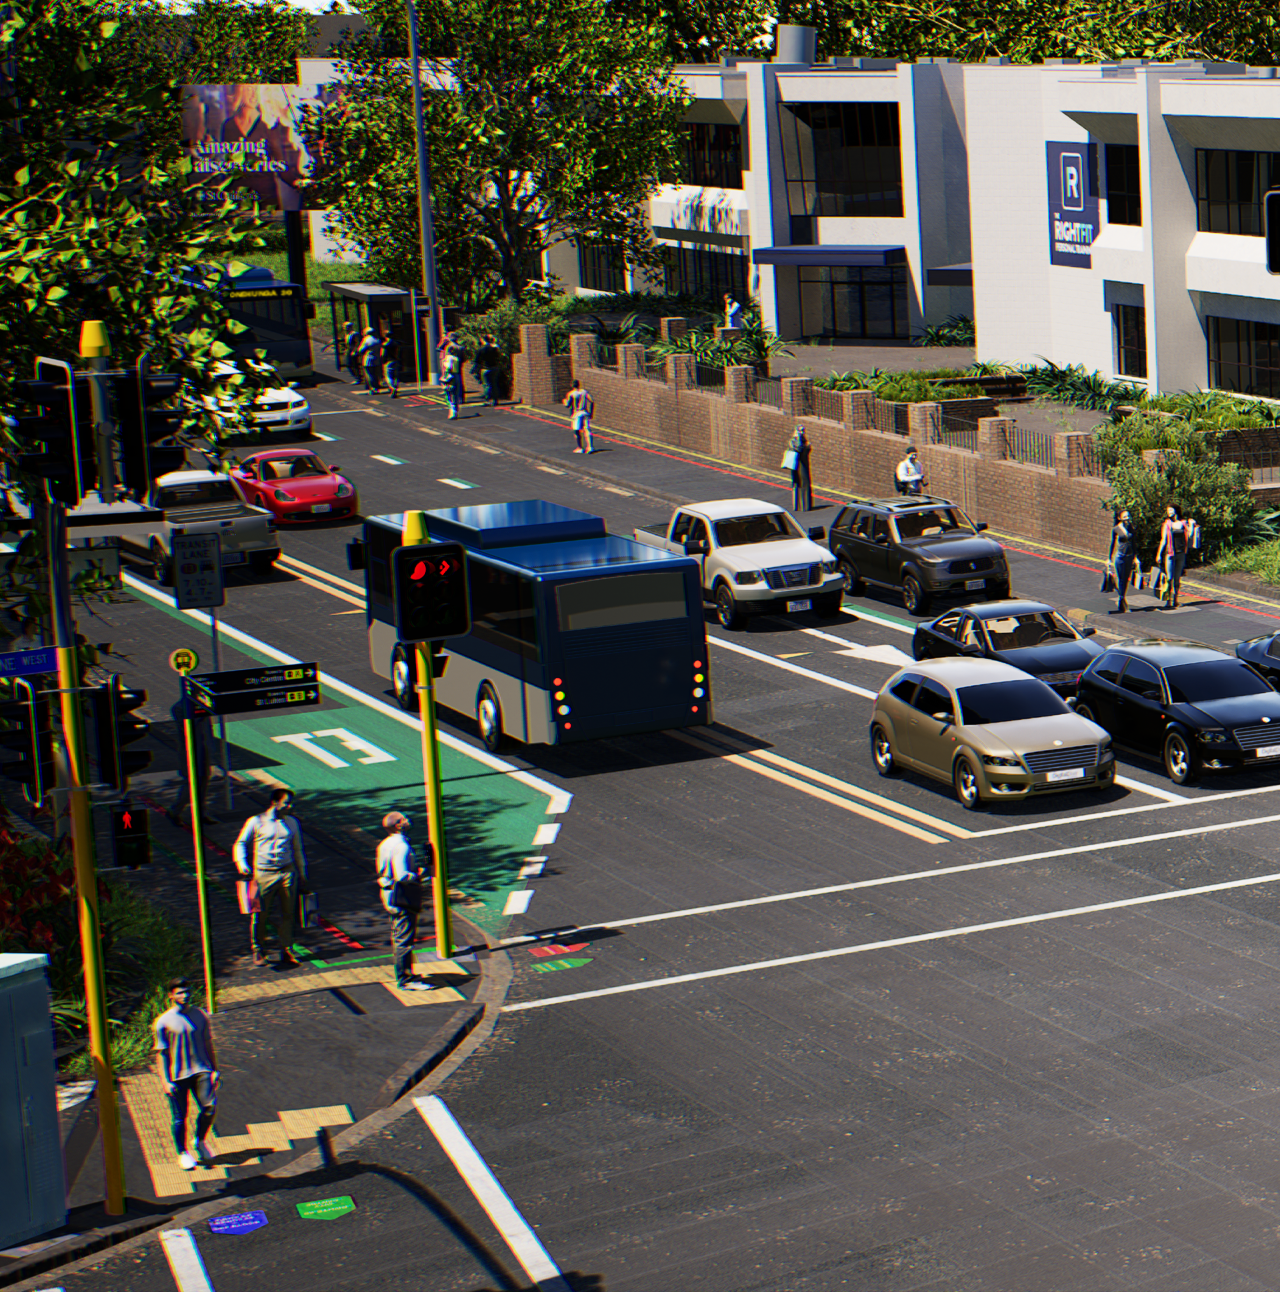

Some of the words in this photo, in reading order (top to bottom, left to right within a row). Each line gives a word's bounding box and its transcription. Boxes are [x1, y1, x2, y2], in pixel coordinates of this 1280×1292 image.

[195, 137, 267, 157] Amazing
[1066, 166, 1080, 198] R
[1054, 220, 1094, 244] RIGHTFIT
[176, 539, 217, 550] TRANSIT
[183, 550, 210, 560] LANE
[21, 653, 48, 666] WEST
[244, 676, 259, 685] City
[260, 675, 284, 683] Centre
[255, 698, 265, 706] St
[265, 696, 286, 705] Lukes
[269, 728, 400, 769] T3
